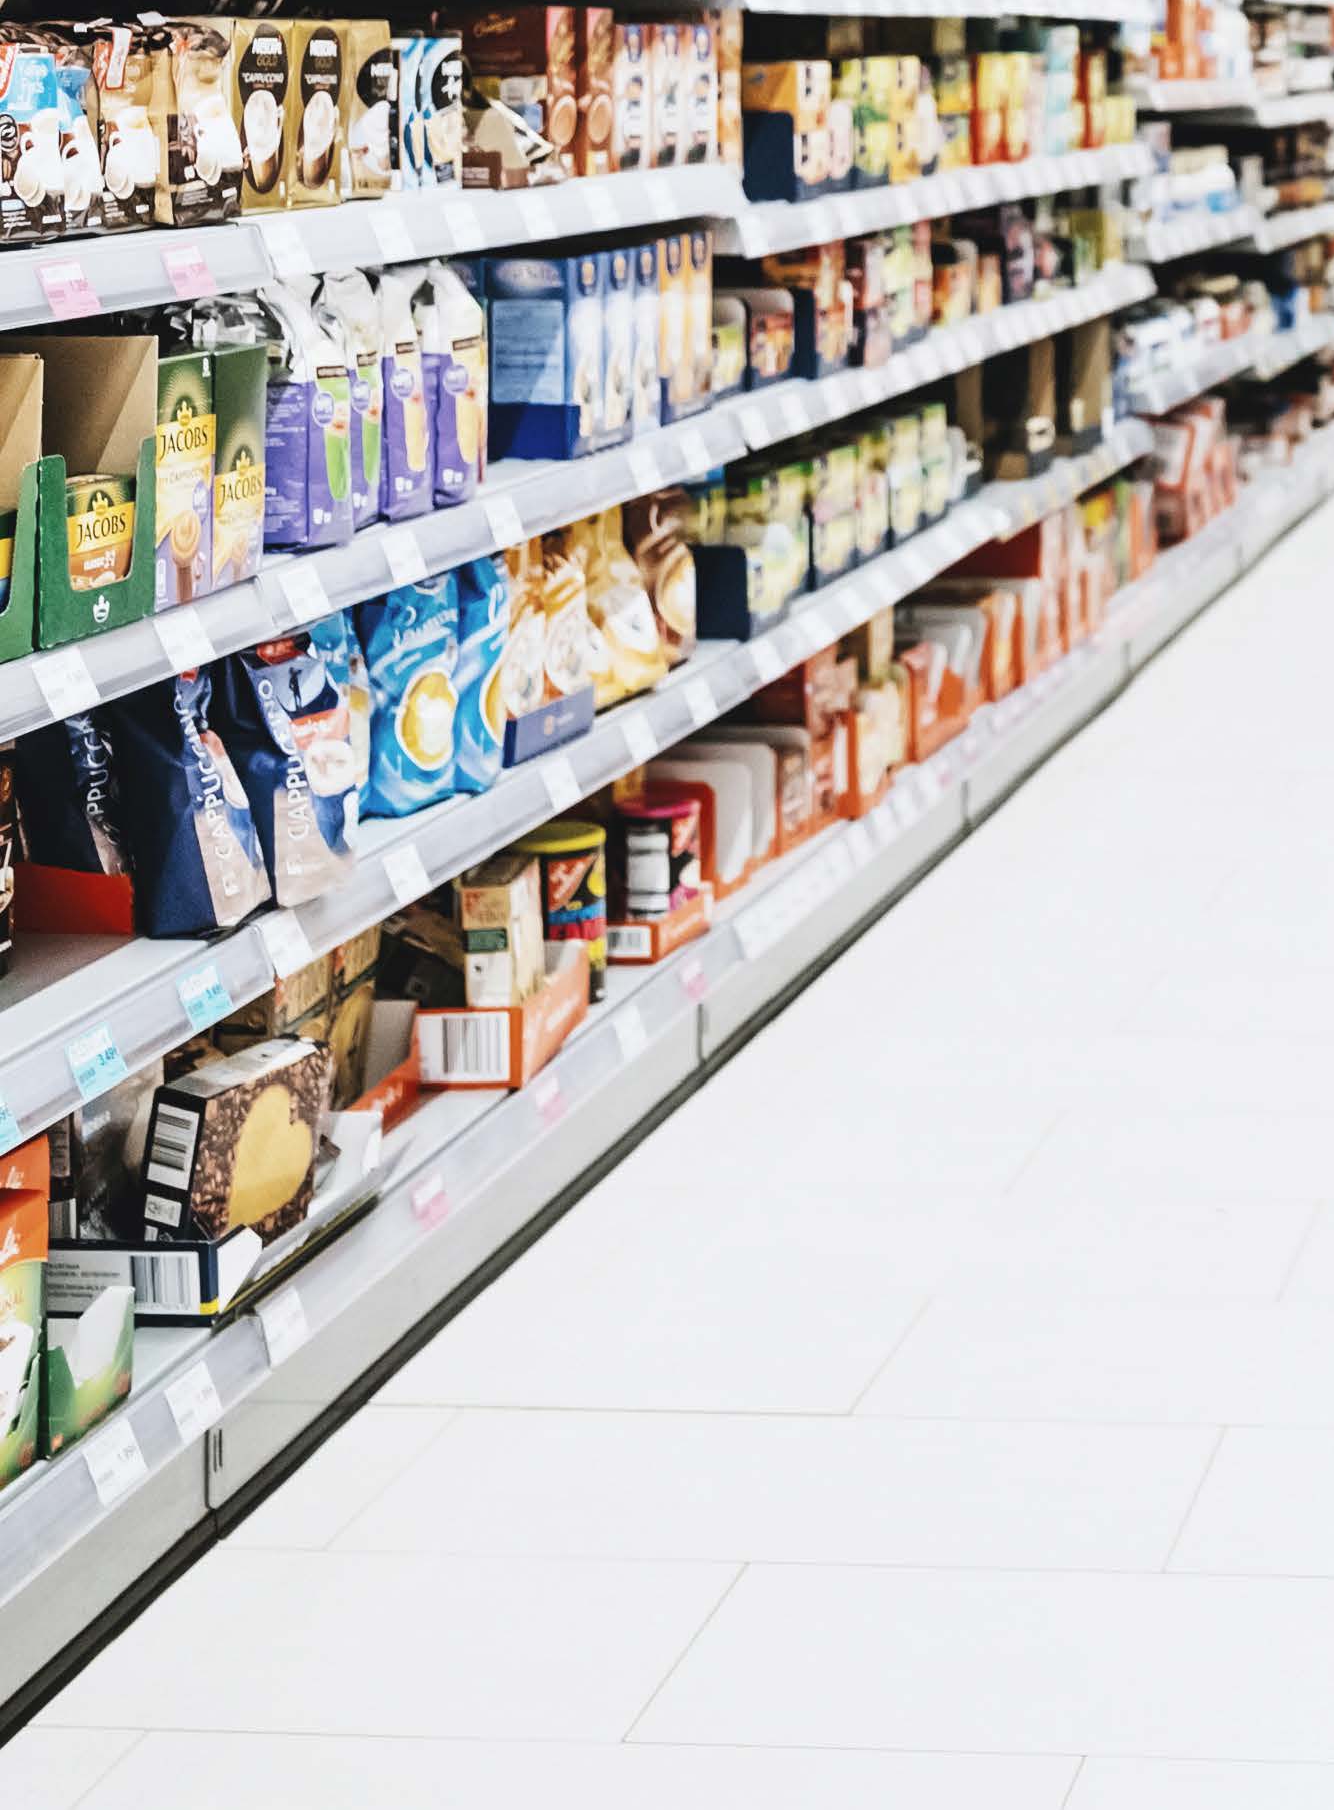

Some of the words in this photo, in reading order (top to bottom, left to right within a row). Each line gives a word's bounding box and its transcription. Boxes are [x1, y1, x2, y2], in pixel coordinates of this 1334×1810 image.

[159, 424, 208, 462] JACOBS
[219, 476, 262, 511] JACOBS
[76, 512, 126, 549] JACOBS
